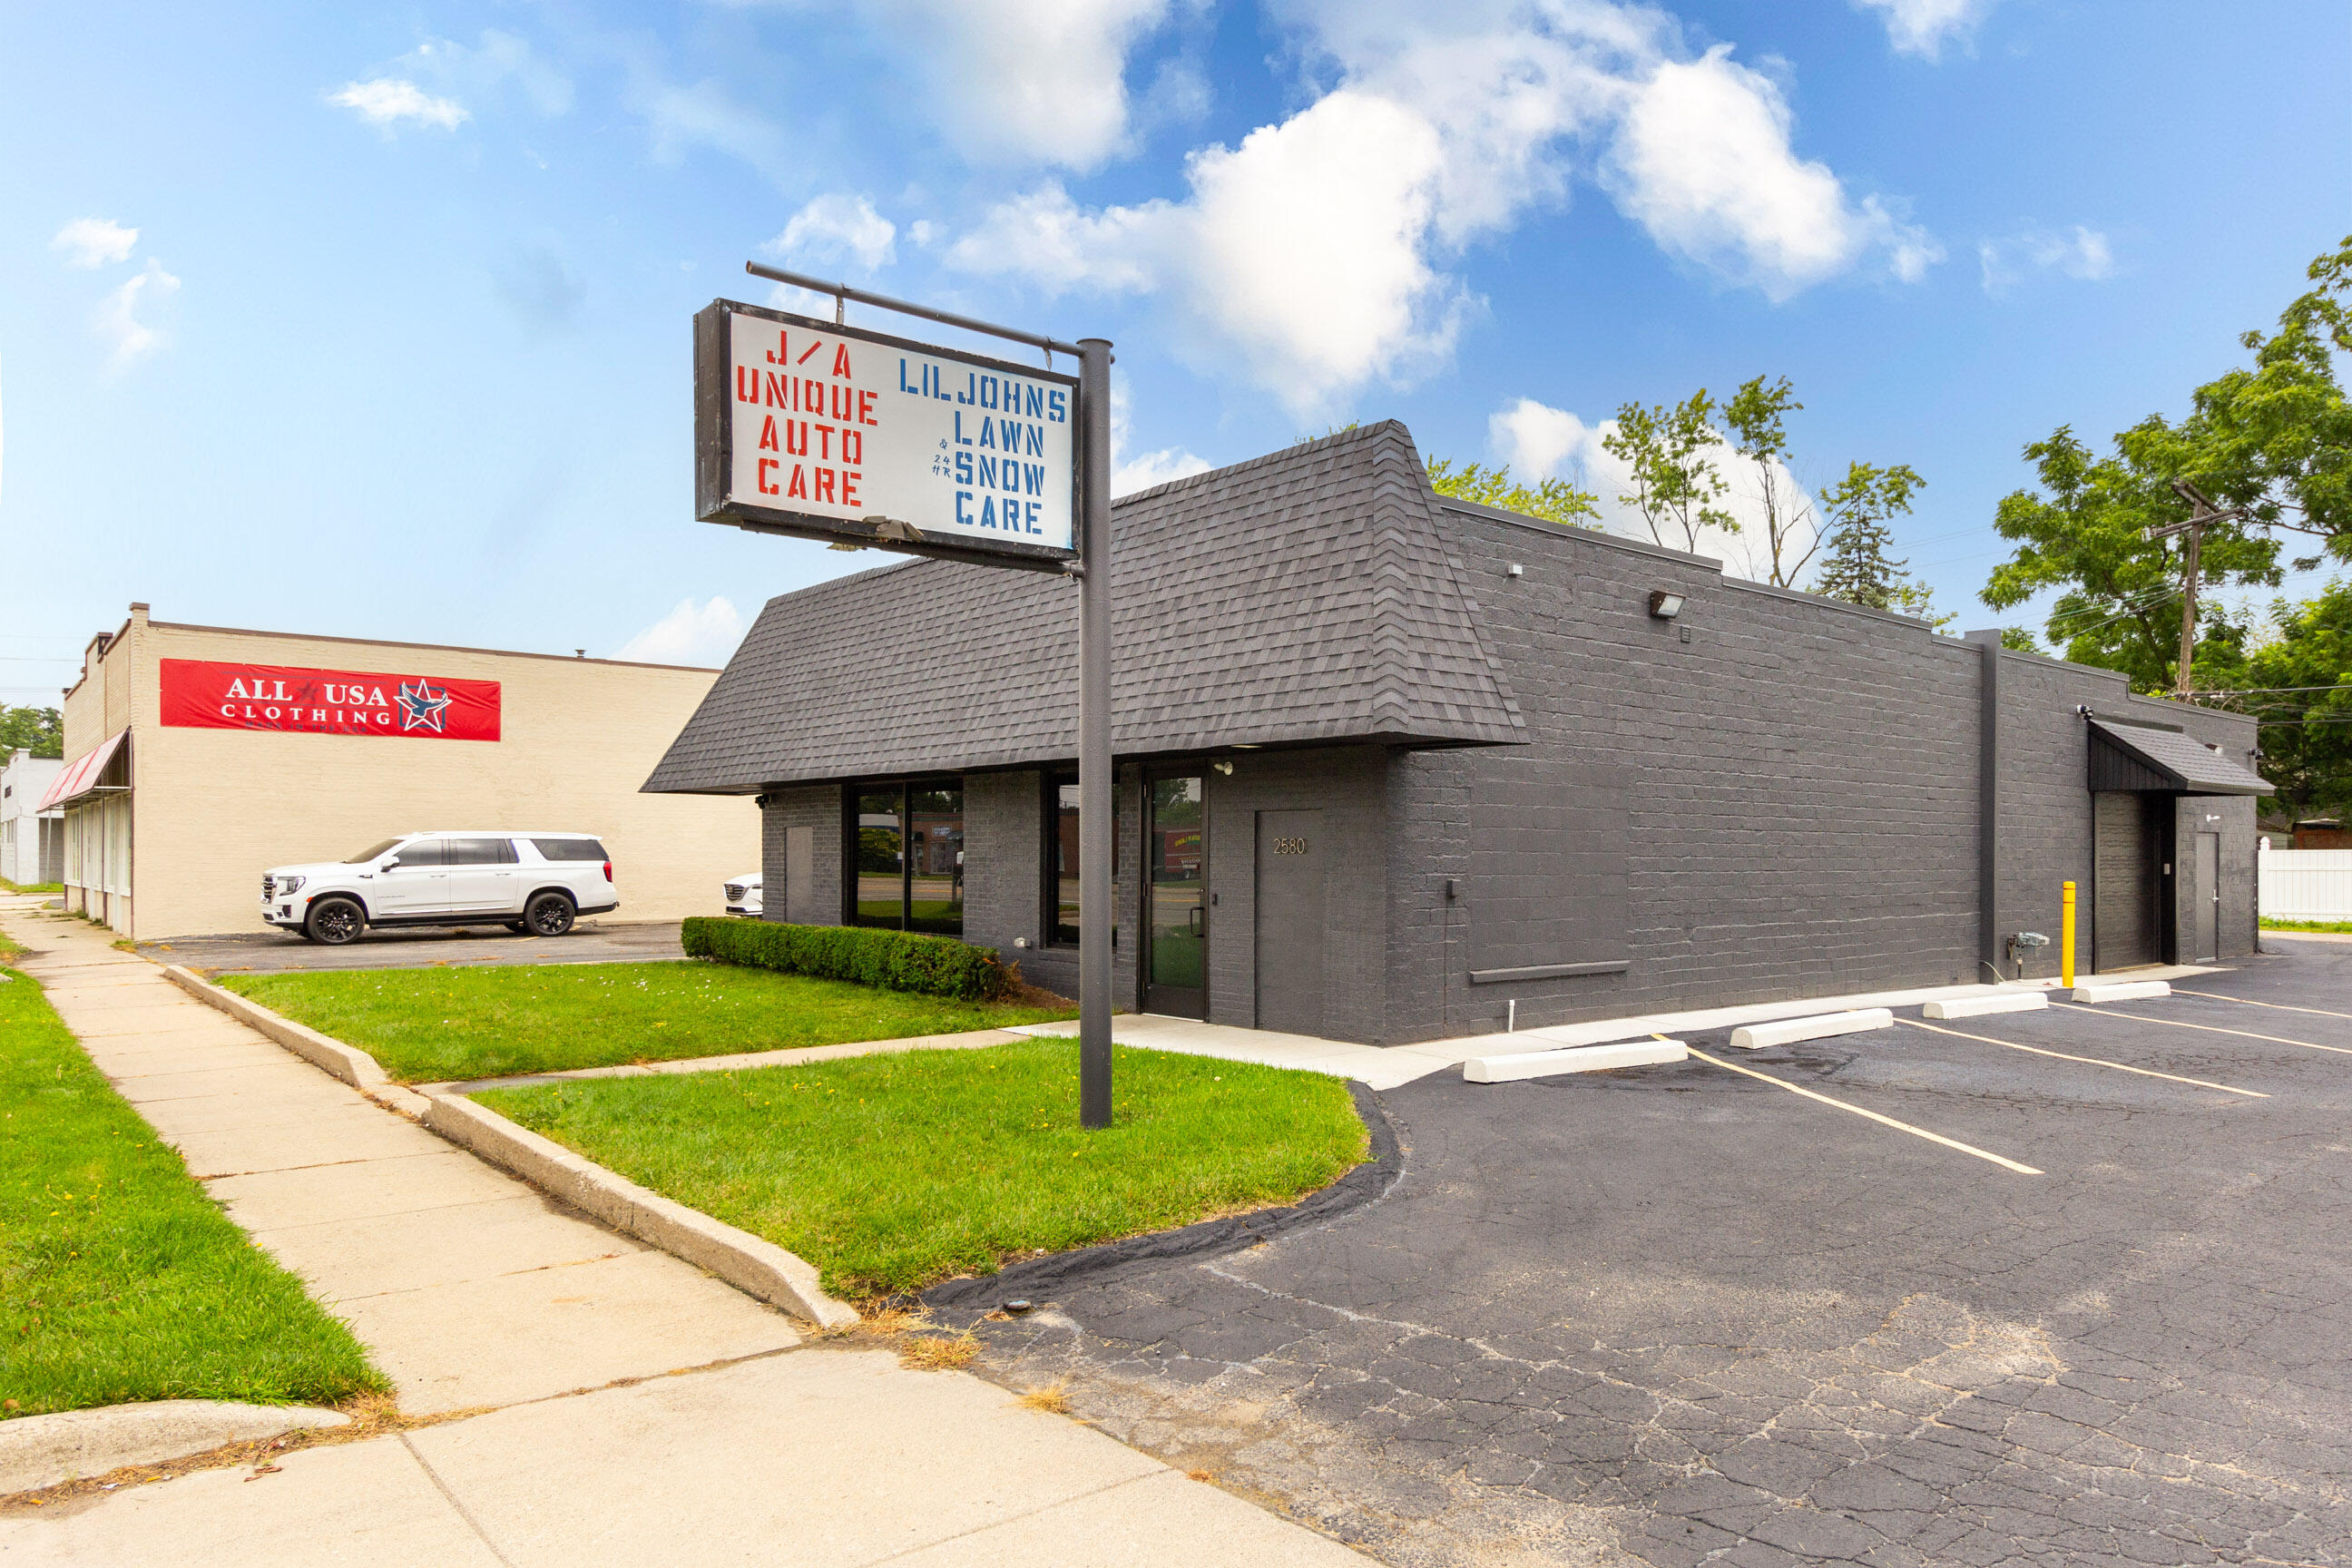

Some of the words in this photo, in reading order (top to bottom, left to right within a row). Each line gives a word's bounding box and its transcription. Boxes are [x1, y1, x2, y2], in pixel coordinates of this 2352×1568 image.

[737, 365, 878, 426] UNIQUE
[759, 414, 862, 466] AUTO
[955, 410, 1044, 458] LAWN
[758, 456, 862, 507] CARE
[932, 465, 951, 478] HR
[934, 454, 951, 466] 24
[956, 451, 1045, 497] SNOW
[956, 490, 1043, 535] CARE
[220, 703, 390, 725] CLOTHING
[225, 677, 293, 701] ALL
[323, 683, 389, 707] USA
[1273, 838, 1305, 854] 2580
